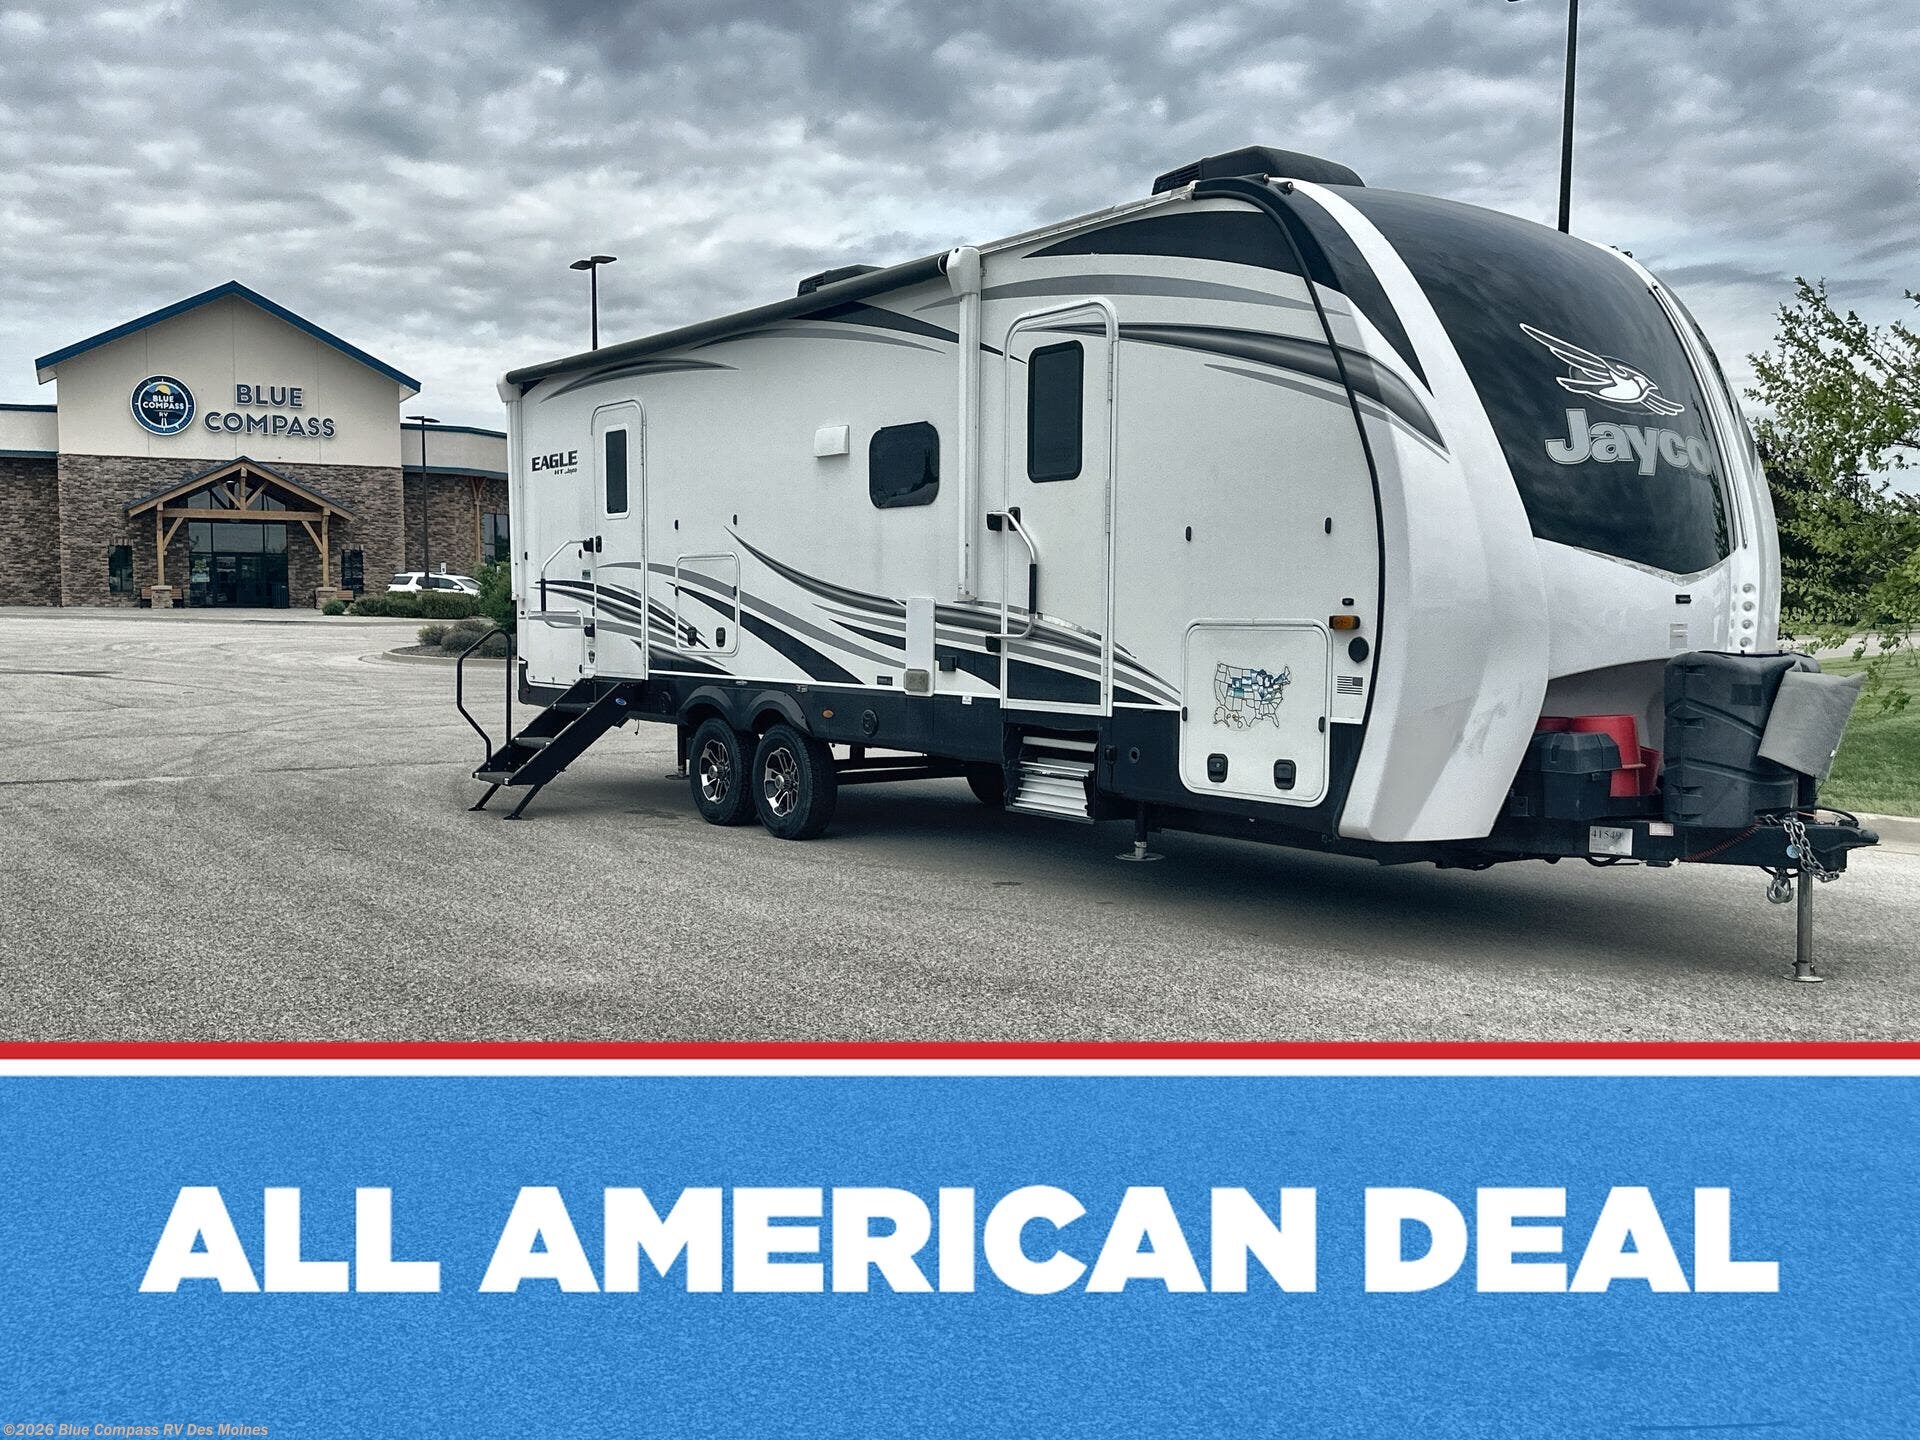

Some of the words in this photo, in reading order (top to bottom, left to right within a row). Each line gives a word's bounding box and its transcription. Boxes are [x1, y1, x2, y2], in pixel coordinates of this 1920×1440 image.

[143, 401, 184, 410] COMPASS
[236, 384, 303, 408] BLUE
[204, 411, 336, 438] COMPASS
[1545, 408, 1712, 476] Jayco
[531, 450, 578, 472] EAGLE
